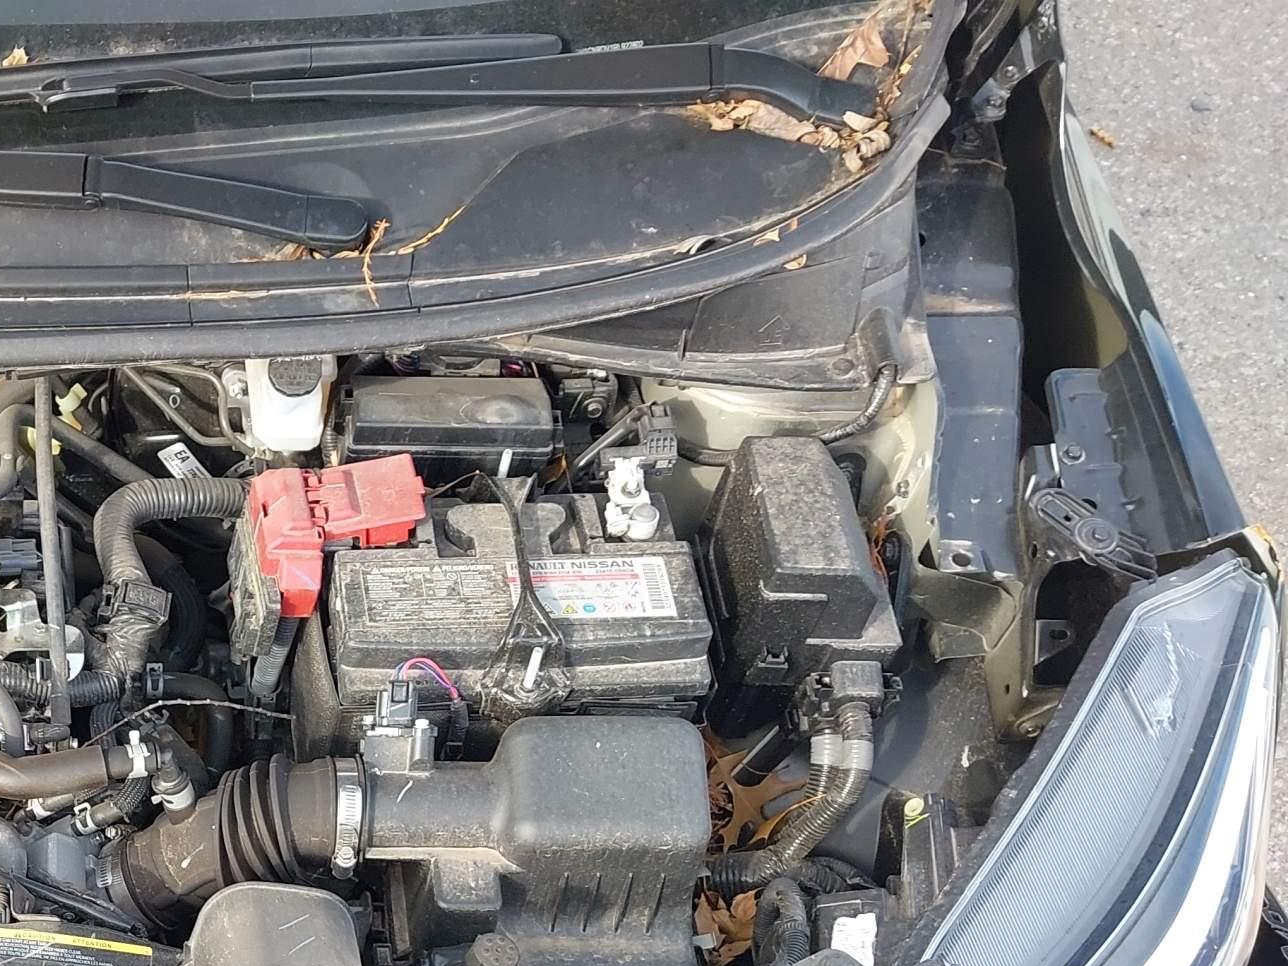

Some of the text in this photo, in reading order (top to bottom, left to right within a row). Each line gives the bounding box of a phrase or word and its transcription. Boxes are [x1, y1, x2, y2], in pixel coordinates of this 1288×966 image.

[174, 449, 191, 464] EA
[570, 560, 634, 569] NISSAN
[72, 938, 112, 949] ATTENTION
